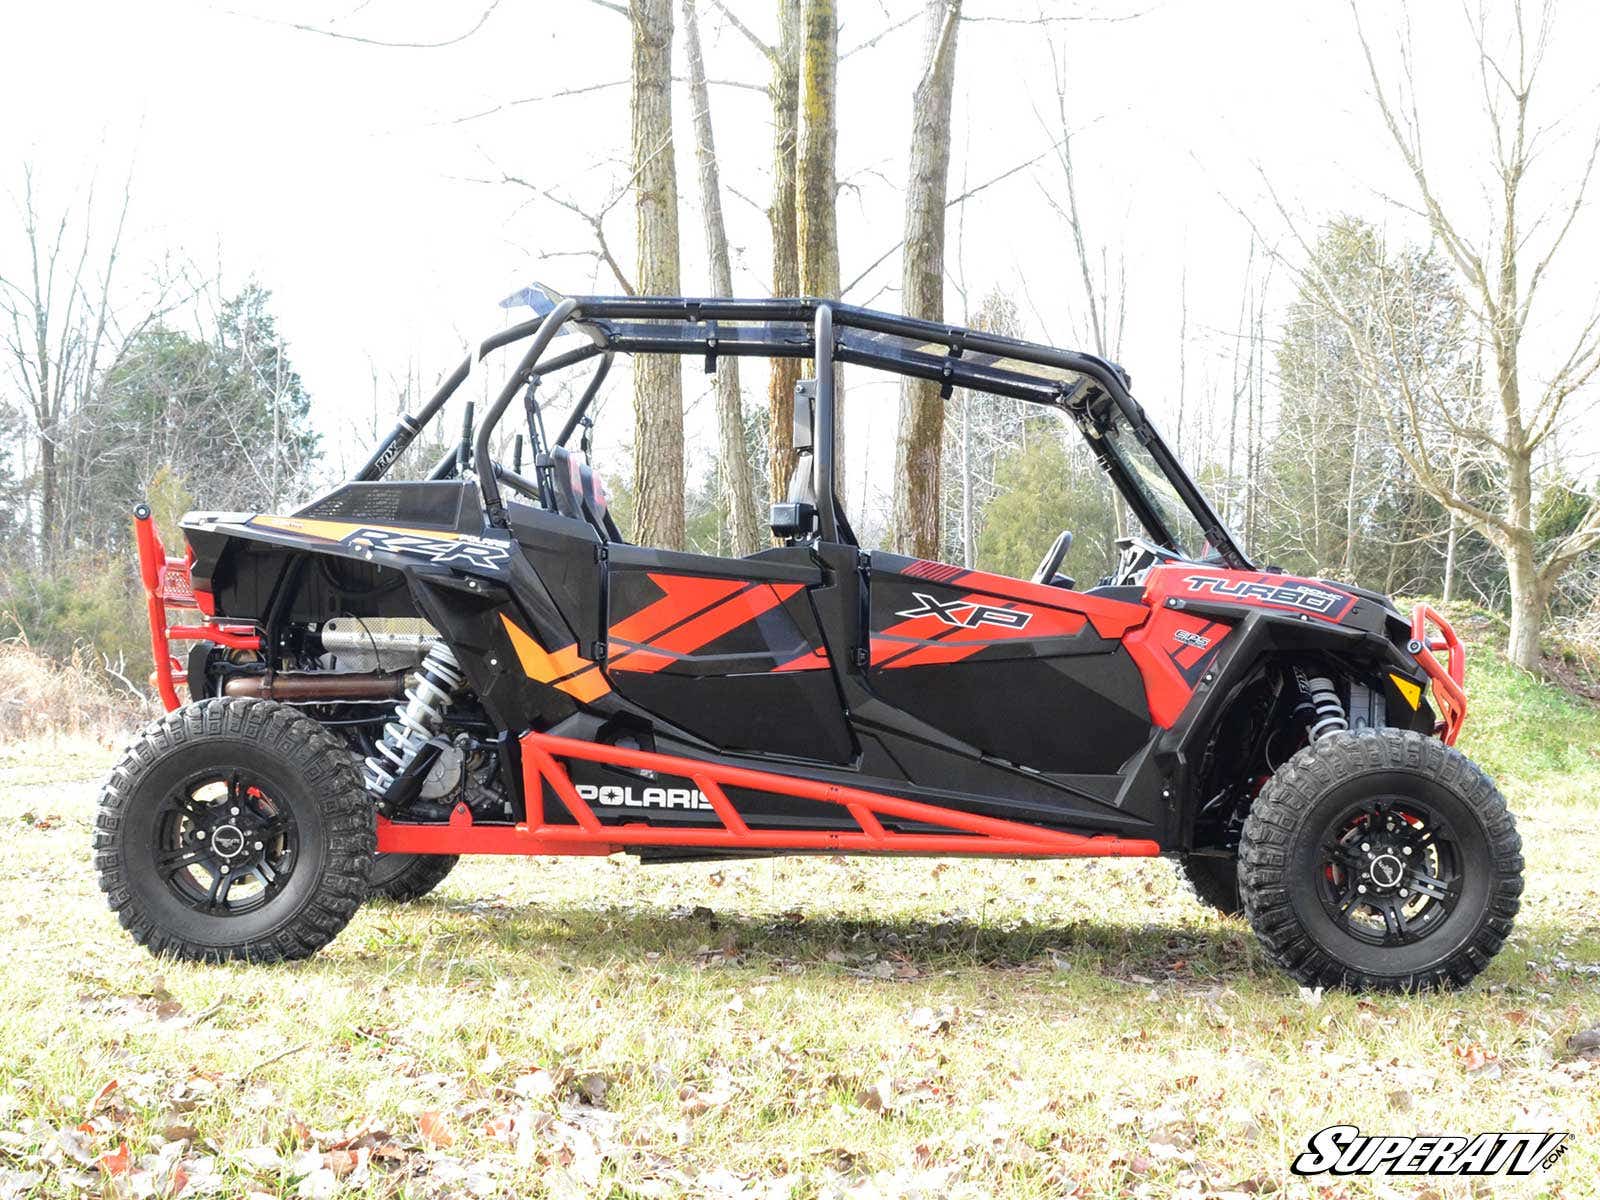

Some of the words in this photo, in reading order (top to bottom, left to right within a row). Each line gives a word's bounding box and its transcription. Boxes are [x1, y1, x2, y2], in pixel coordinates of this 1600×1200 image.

[375, 440, 398, 471] FOX
[340, 527, 510, 570] RZR
[895, 592, 1034, 630] XP
[1184, 575, 1336, 613] TURBO
